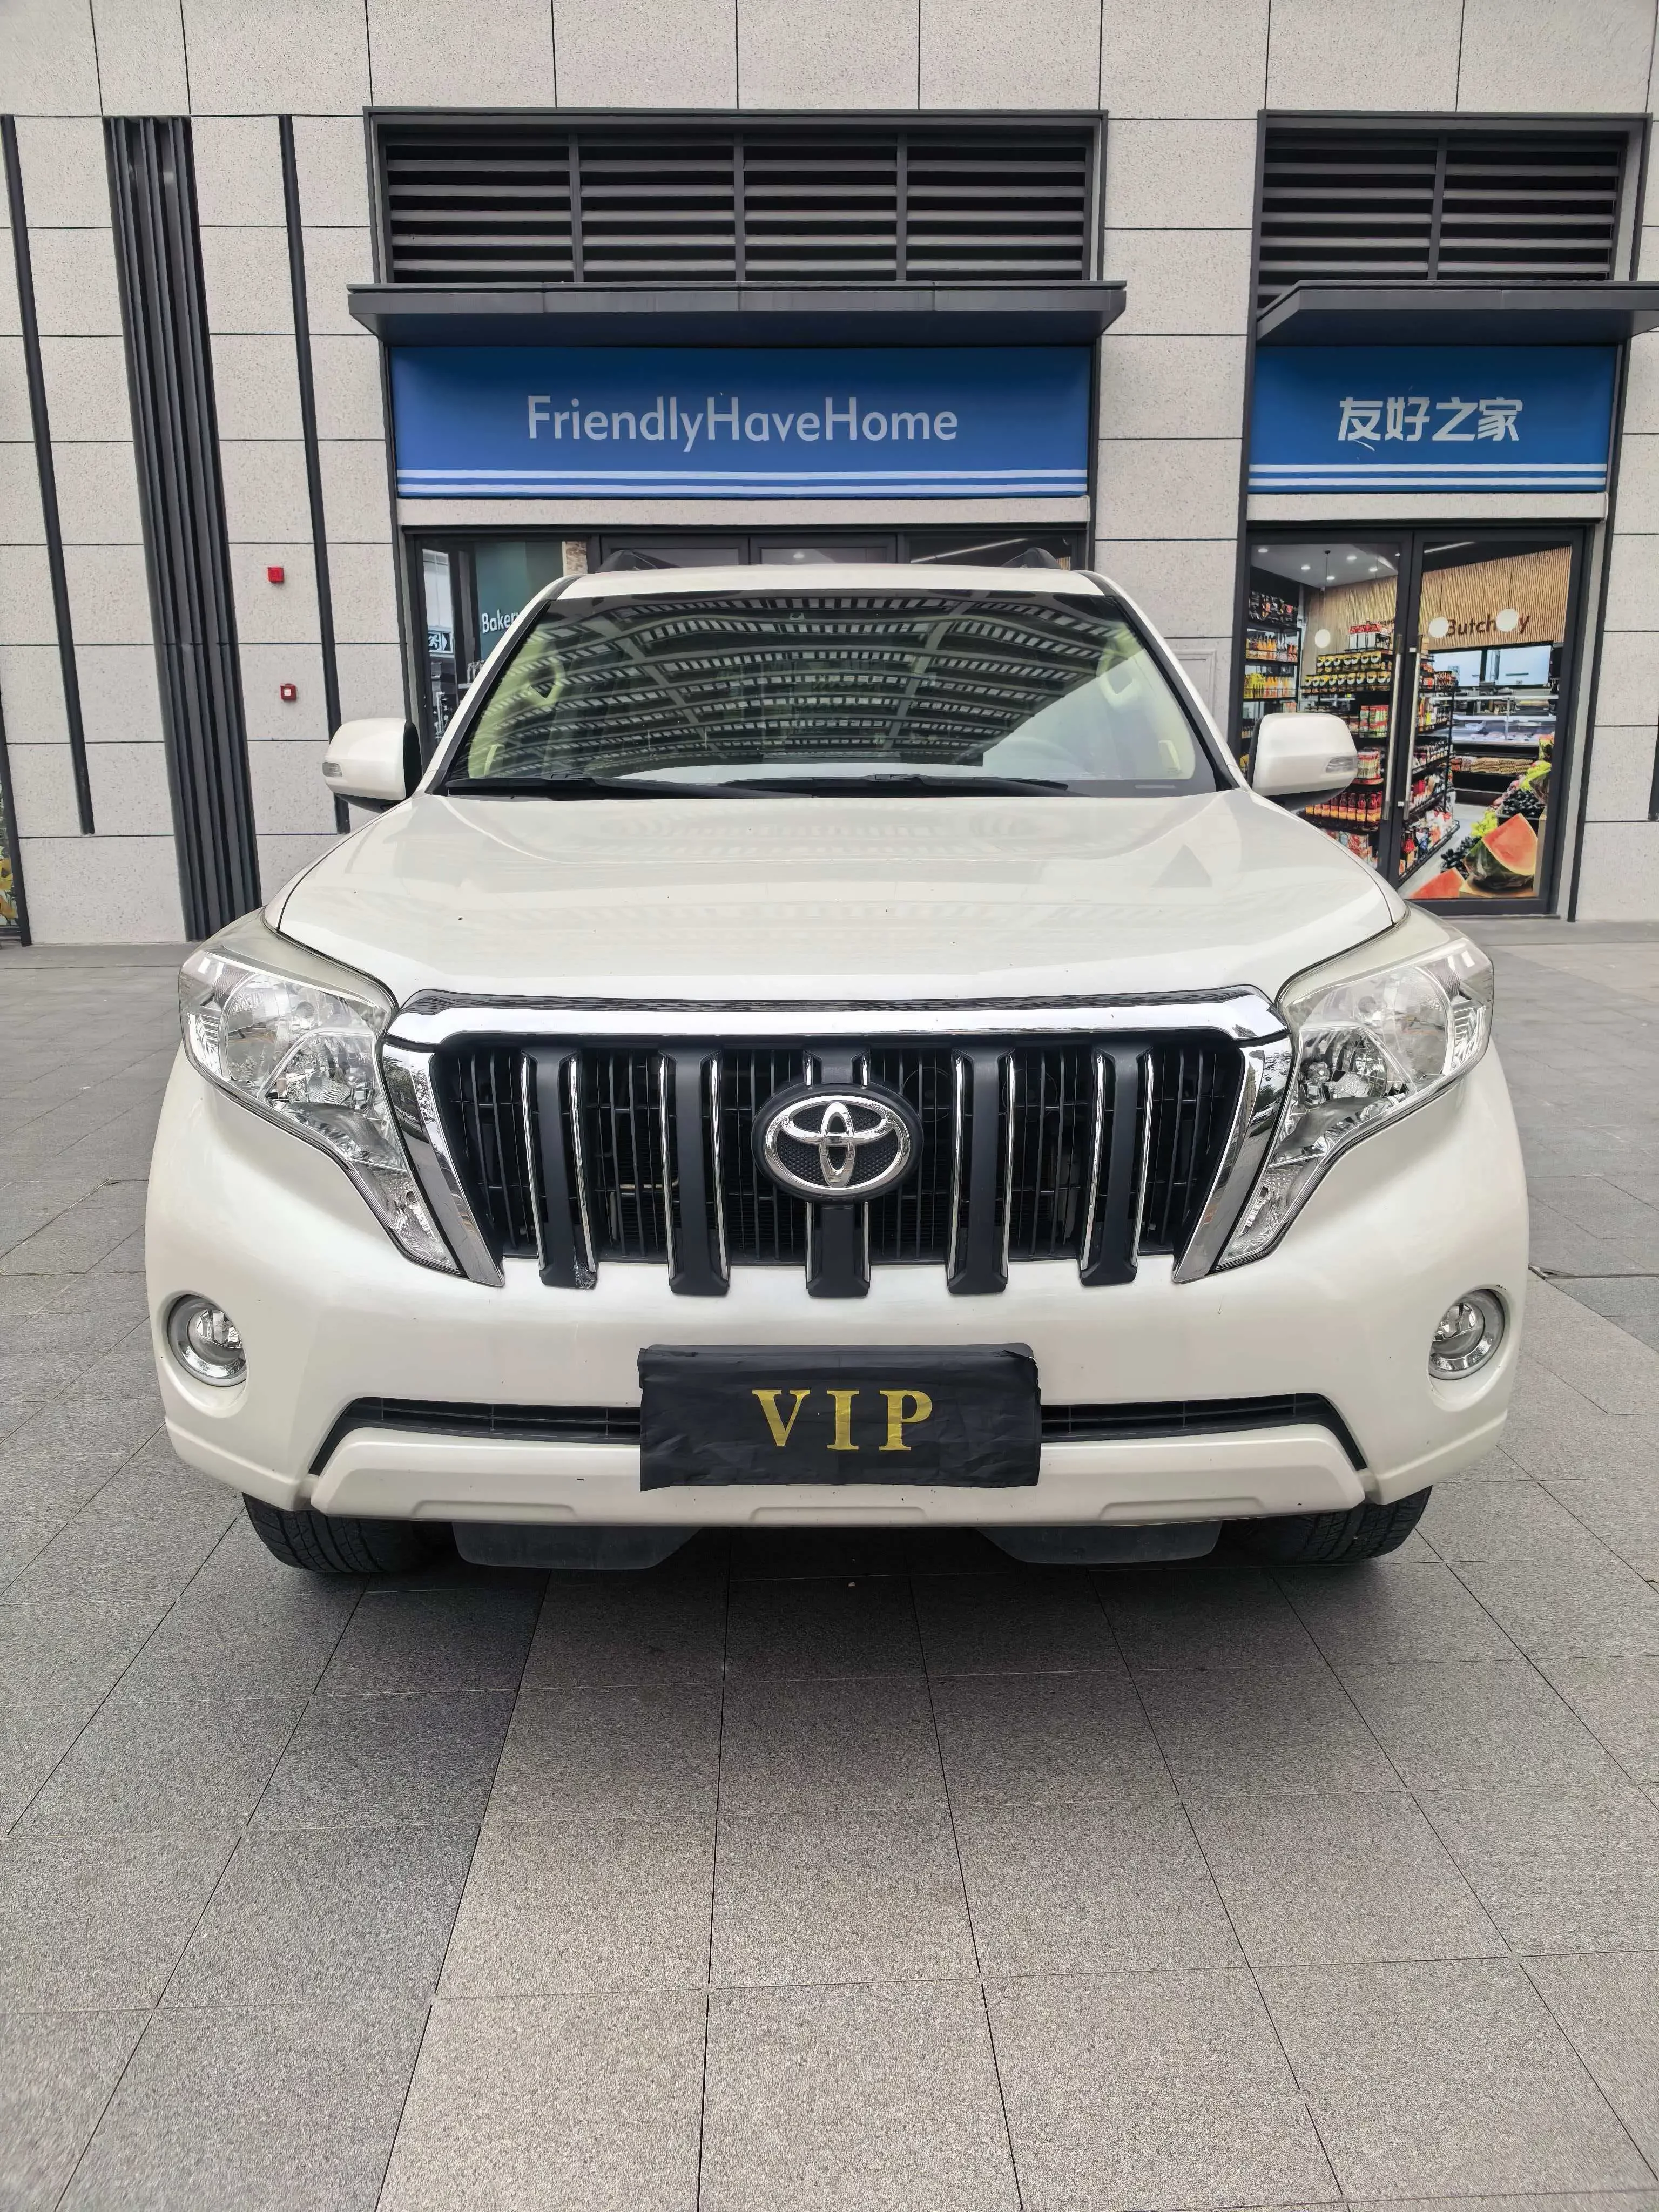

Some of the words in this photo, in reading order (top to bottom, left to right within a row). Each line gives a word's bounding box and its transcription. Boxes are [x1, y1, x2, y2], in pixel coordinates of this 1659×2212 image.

[528, 395, 958, 453] FriendlyHaveHome
[1338, 397, 1523, 441] 友好之家
[482, 609, 519, 633] Baker
[1446, 613, 1531, 636] Butchy
[752, 1390, 933, 1451] VIP
